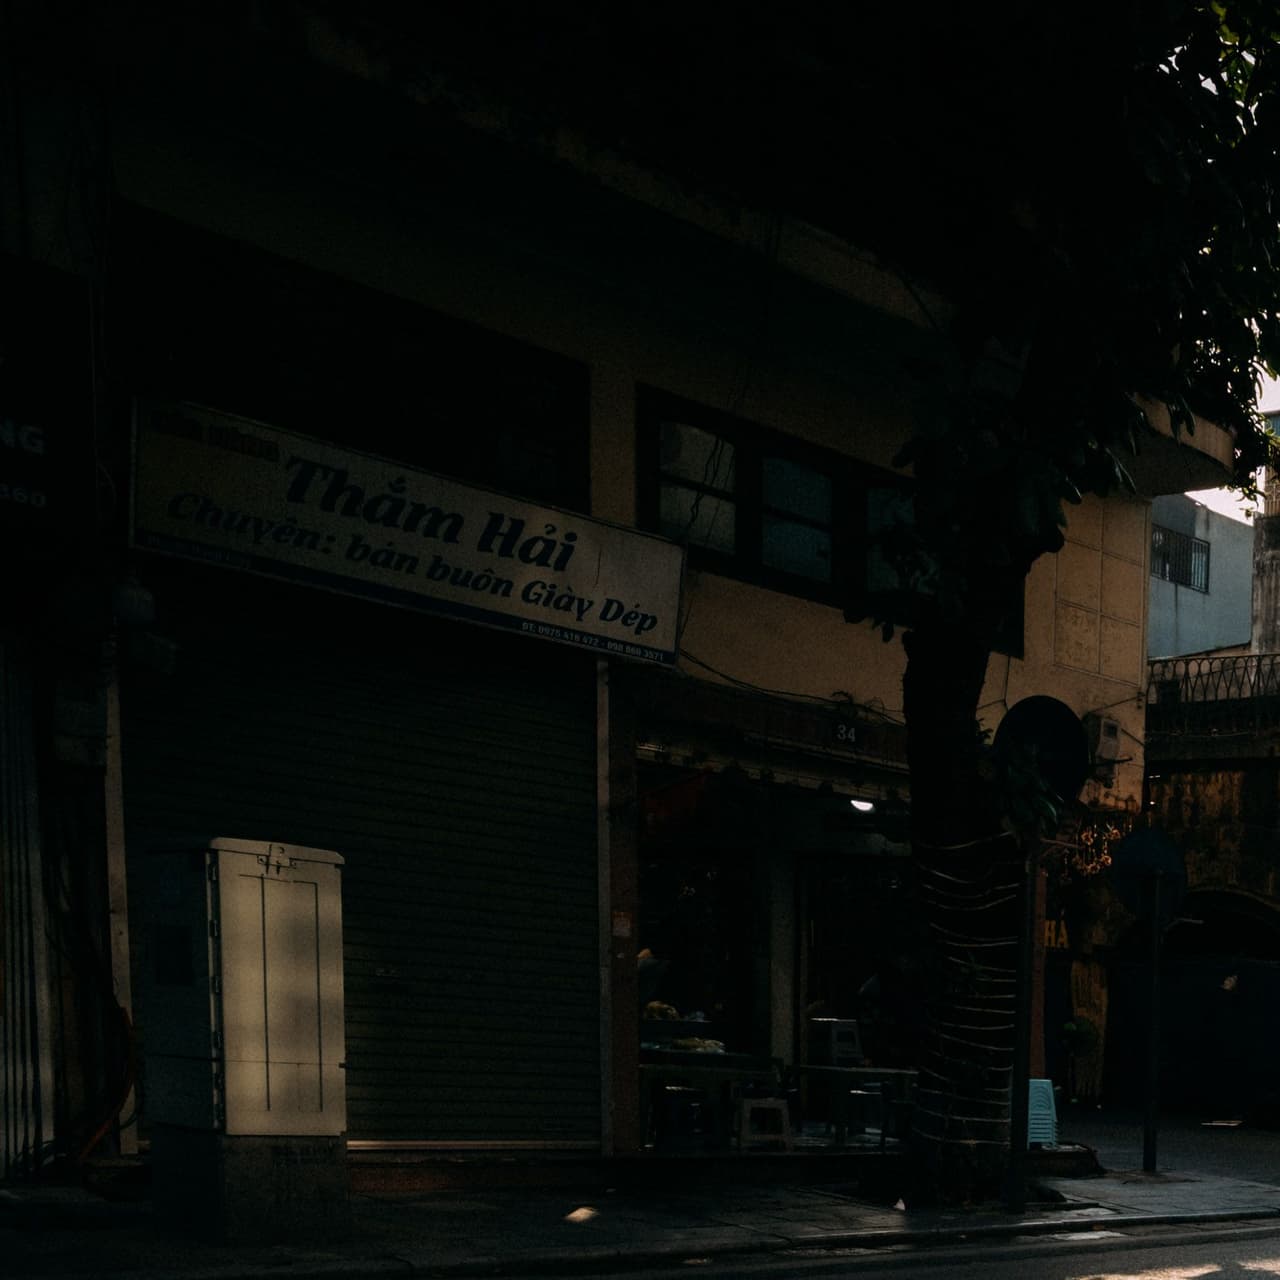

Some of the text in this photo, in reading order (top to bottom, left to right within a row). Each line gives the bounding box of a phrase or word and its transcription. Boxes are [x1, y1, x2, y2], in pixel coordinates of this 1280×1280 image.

[167, 492, 337, 554] Chuyên:
[345, 534, 419, 574] bán
[425, 554, 513, 598] buôn
[521, 580, 595, 622] Giày
[599, 597, 658, 635] Dép
[286, 455, 578, 571] Thắm Hải
[836, 723, 857, 743] 34
